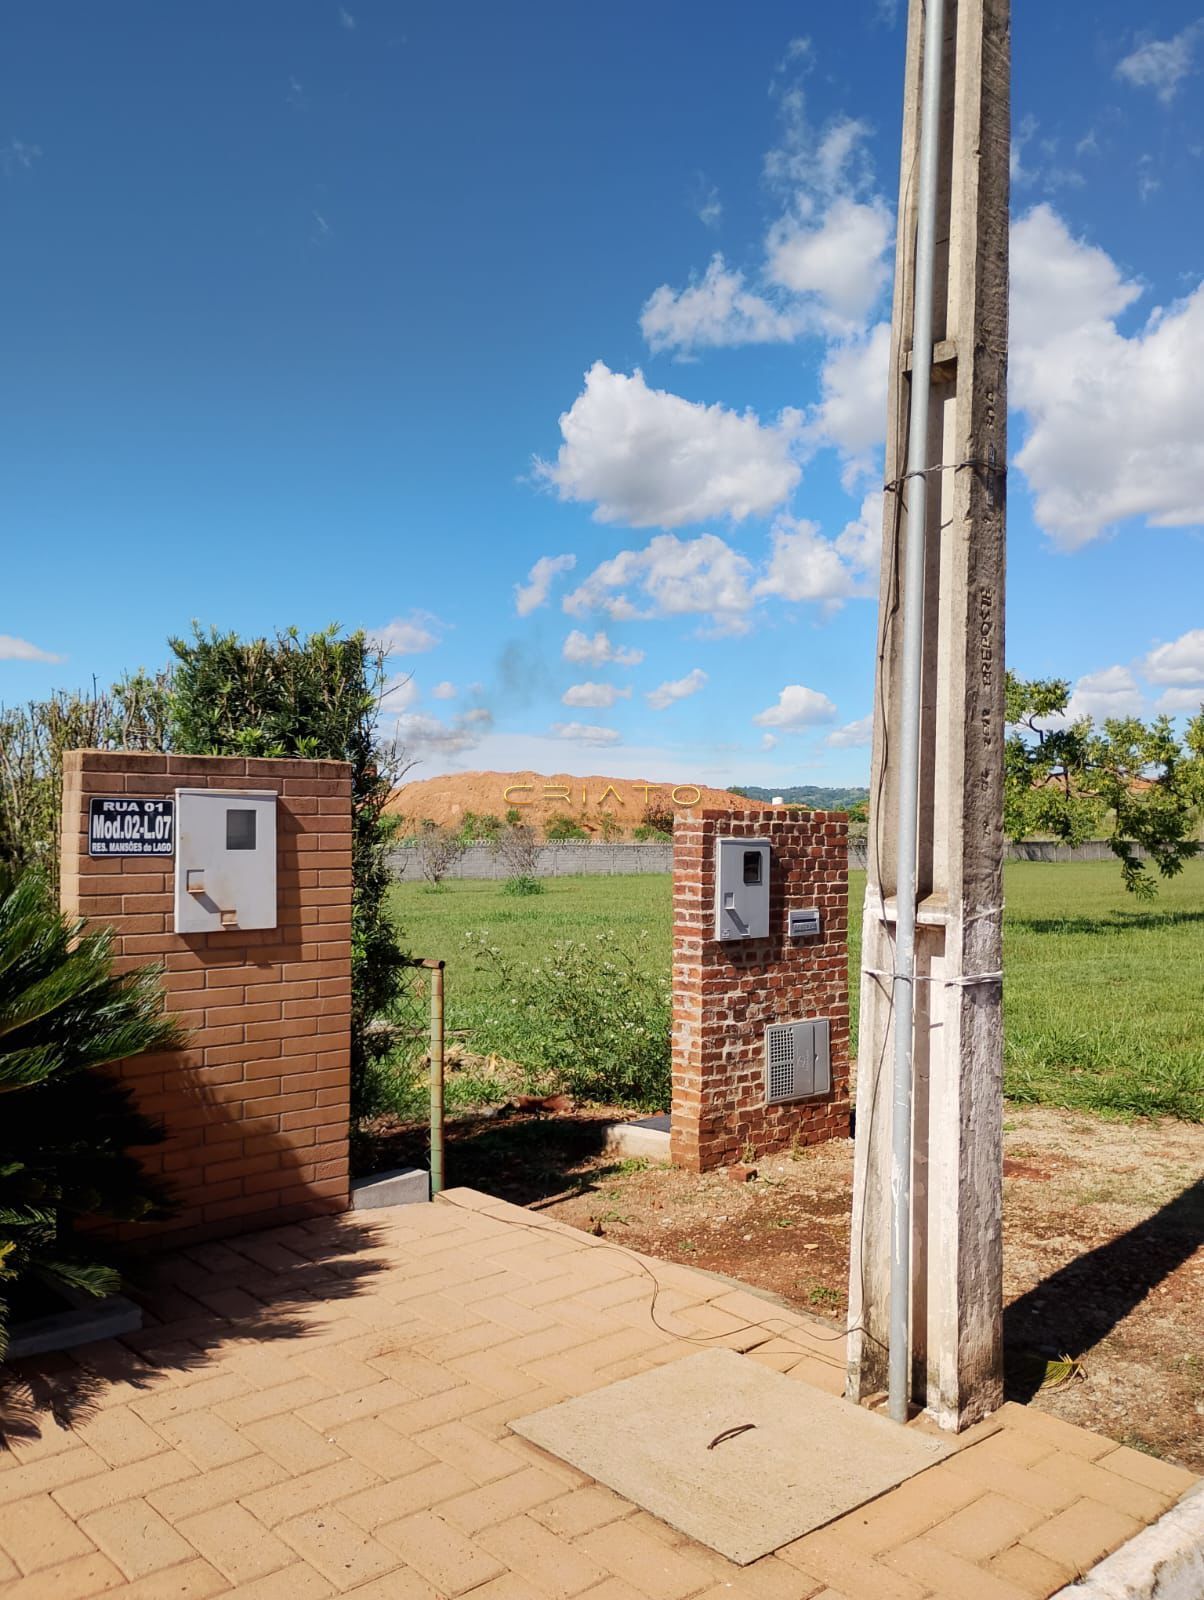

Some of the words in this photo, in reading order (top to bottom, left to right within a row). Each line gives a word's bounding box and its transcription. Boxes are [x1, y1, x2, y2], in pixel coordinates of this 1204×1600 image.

[103, 801, 140, 812] RUA
[144, 802, 164, 812] 01
[92, 842, 108, 852] RES.
[109, 841, 142, 852] MANSÕES
[143, 842, 152, 852] do
[152, 842, 172, 852] LAGO
